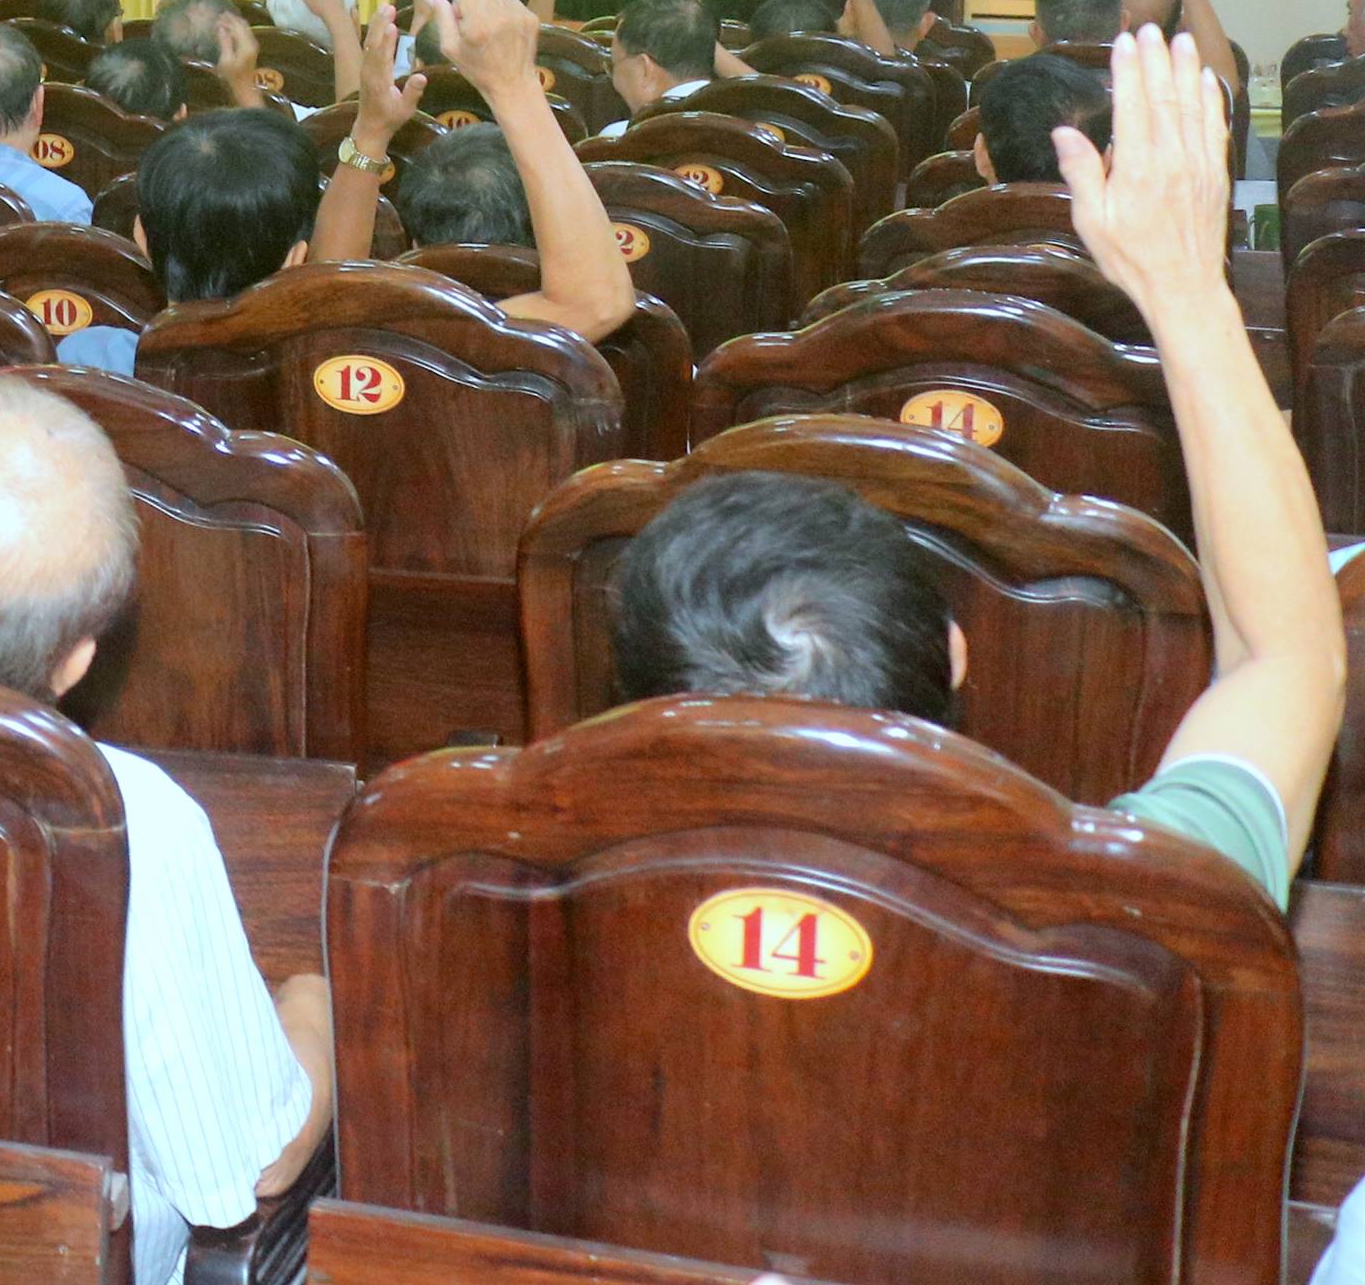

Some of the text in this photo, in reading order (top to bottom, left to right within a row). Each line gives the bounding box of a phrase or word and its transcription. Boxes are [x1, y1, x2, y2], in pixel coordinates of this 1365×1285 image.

[33, 139, 66, 160] 08
[39, 298, 78, 327] 10
[335, 364, 383, 404] 12
[927, 401, 978, 440] 14
[739, 905, 834, 980] 14
